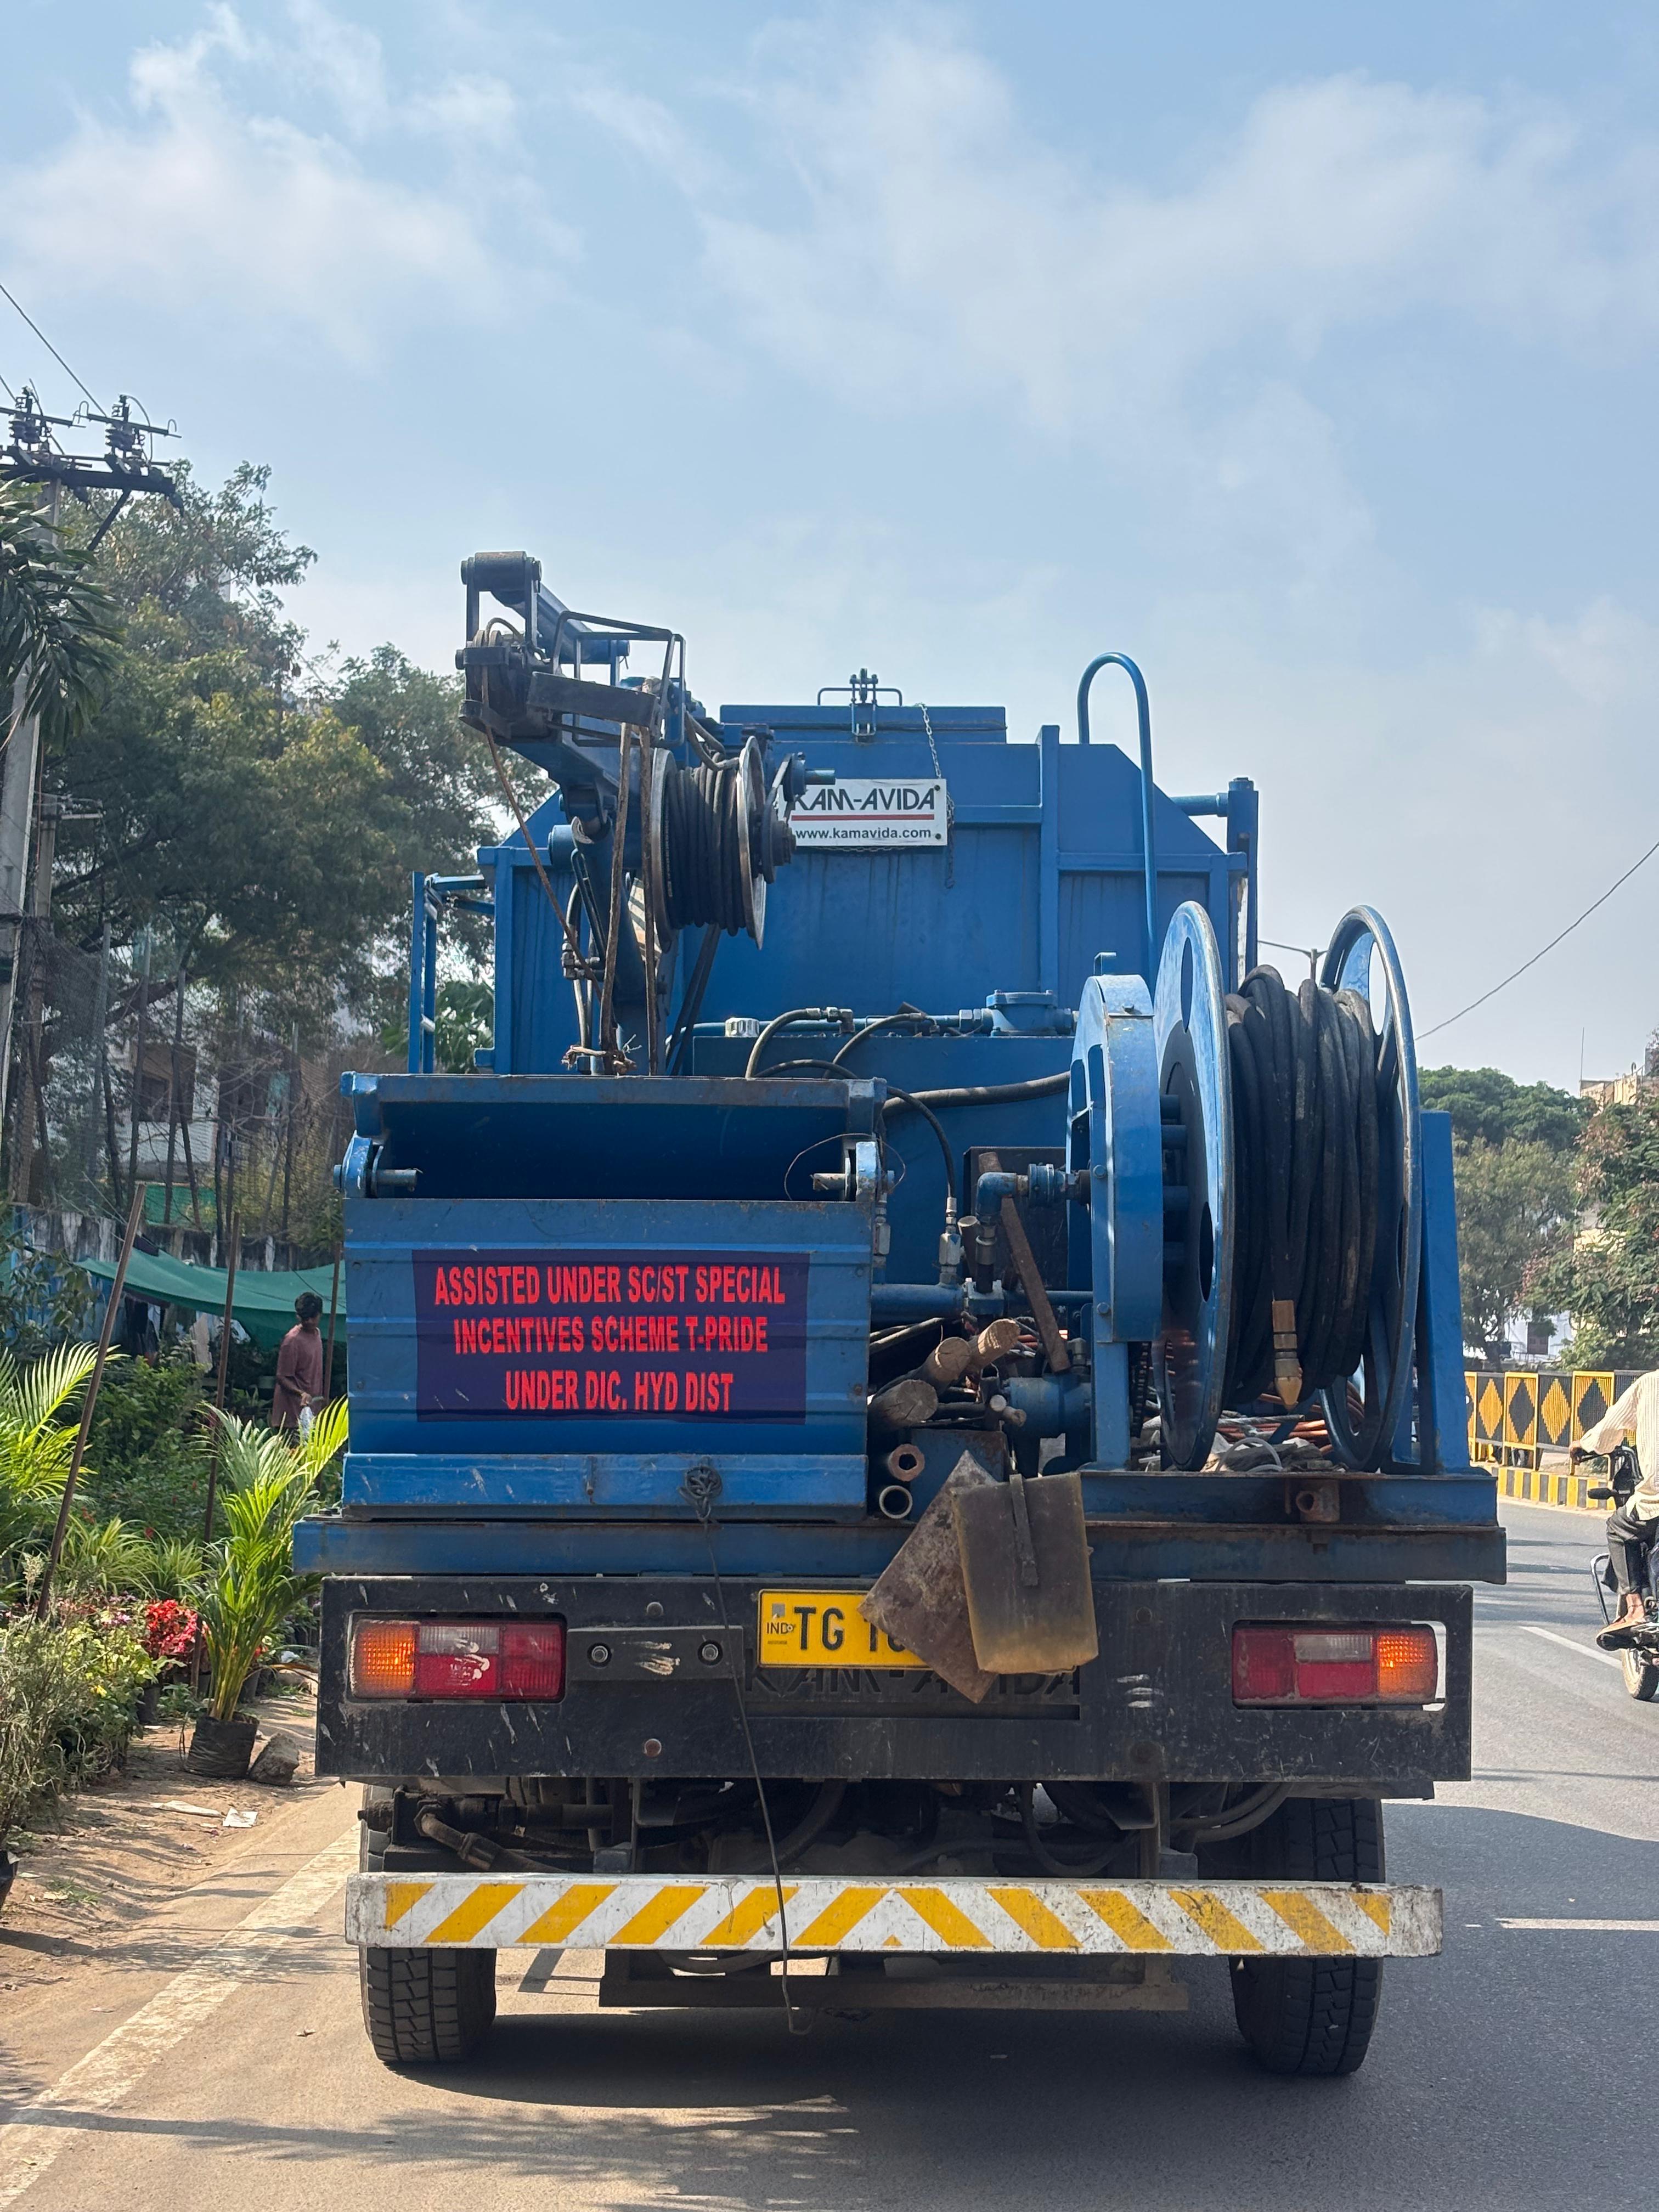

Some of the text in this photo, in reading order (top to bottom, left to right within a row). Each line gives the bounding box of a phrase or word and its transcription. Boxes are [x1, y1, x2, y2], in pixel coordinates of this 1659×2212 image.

[795, 827, 931, 839] www.kamavida.com
[435, 1266, 786, 1305] ASSISTED UNDER SC/ST SPECIAL
[454, 1316, 768, 1354] INCENTIVES SCHEME T-PRIDE
[505, 1370, 733, 1412] UNDER DIC. HYD DIST
[766, 1622, 791, 1634] IND
[794, 1606, 844, 1651] TG
